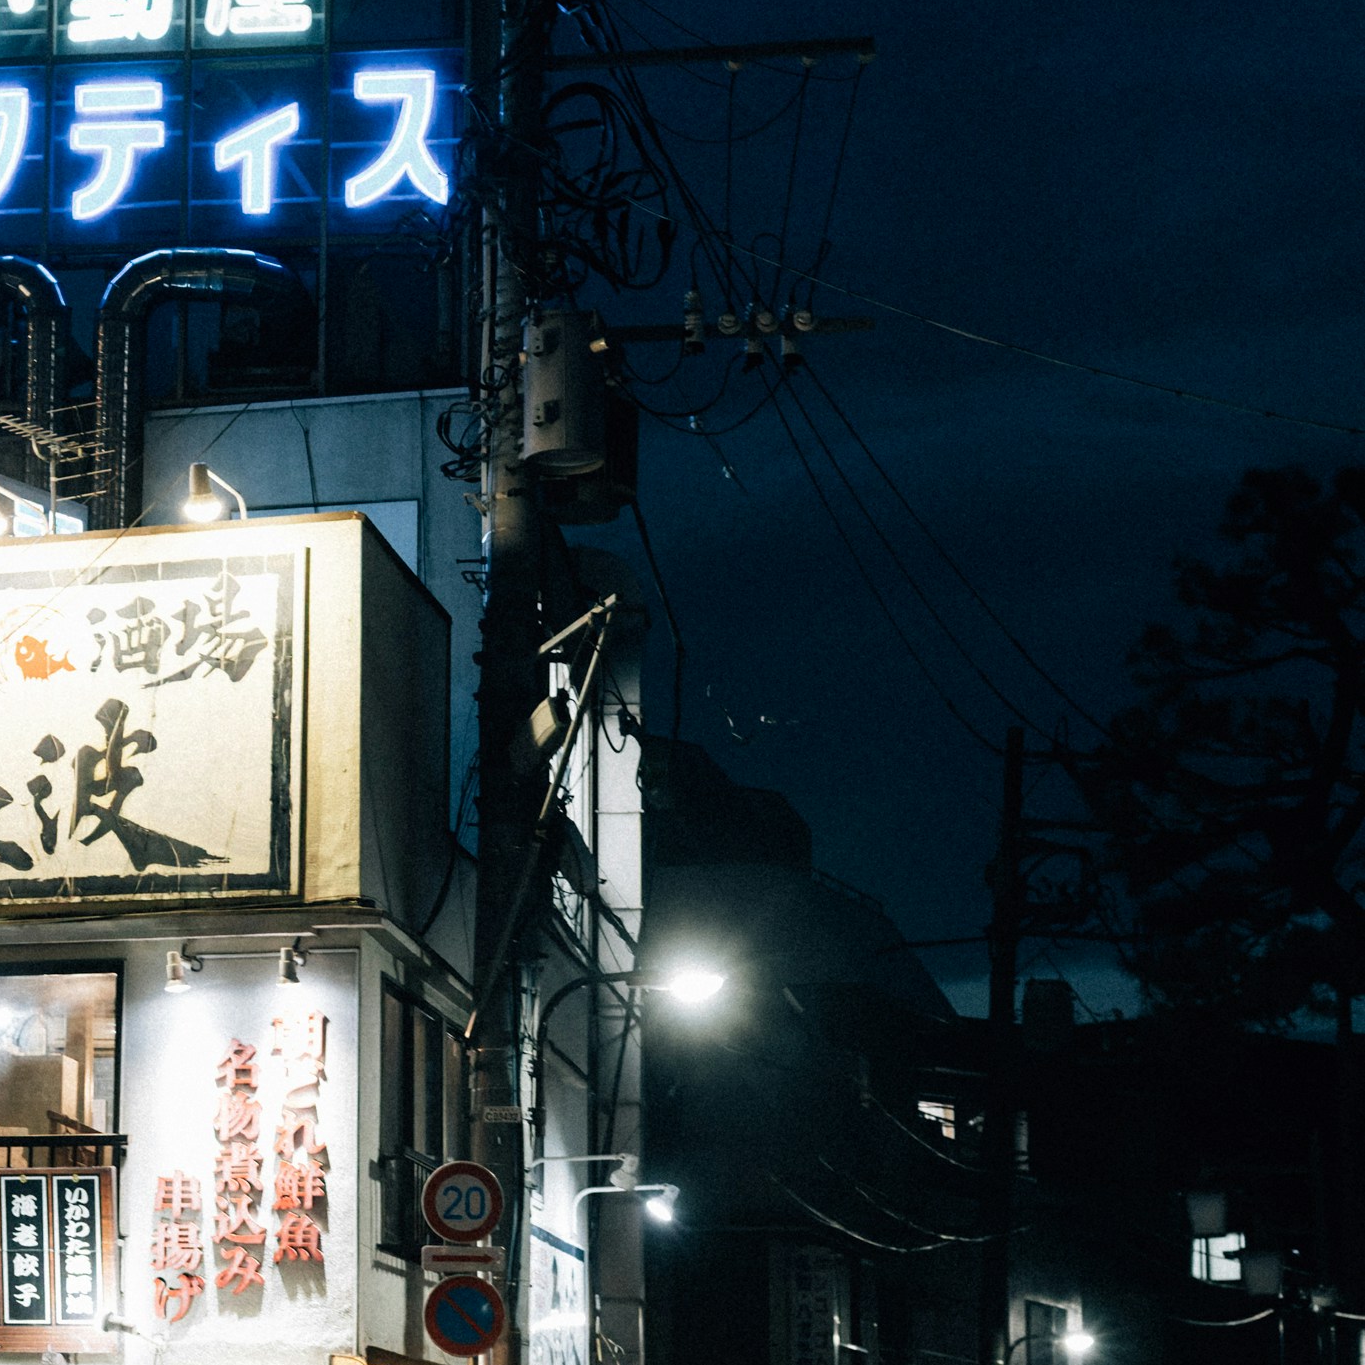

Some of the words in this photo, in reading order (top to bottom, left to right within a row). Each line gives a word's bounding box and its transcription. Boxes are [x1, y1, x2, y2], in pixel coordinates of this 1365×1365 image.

[86, 571, 269, 690] 酒場
[213, 1037, 267, 1296] 名物煮込み
[442, 1185, 486, 1221] 20
[11, 1193, 41, 1308] 海老餃子
[63, 1186, 94, 1316] いかわた
[150, 1168, 205, 1325] 串揚げ
